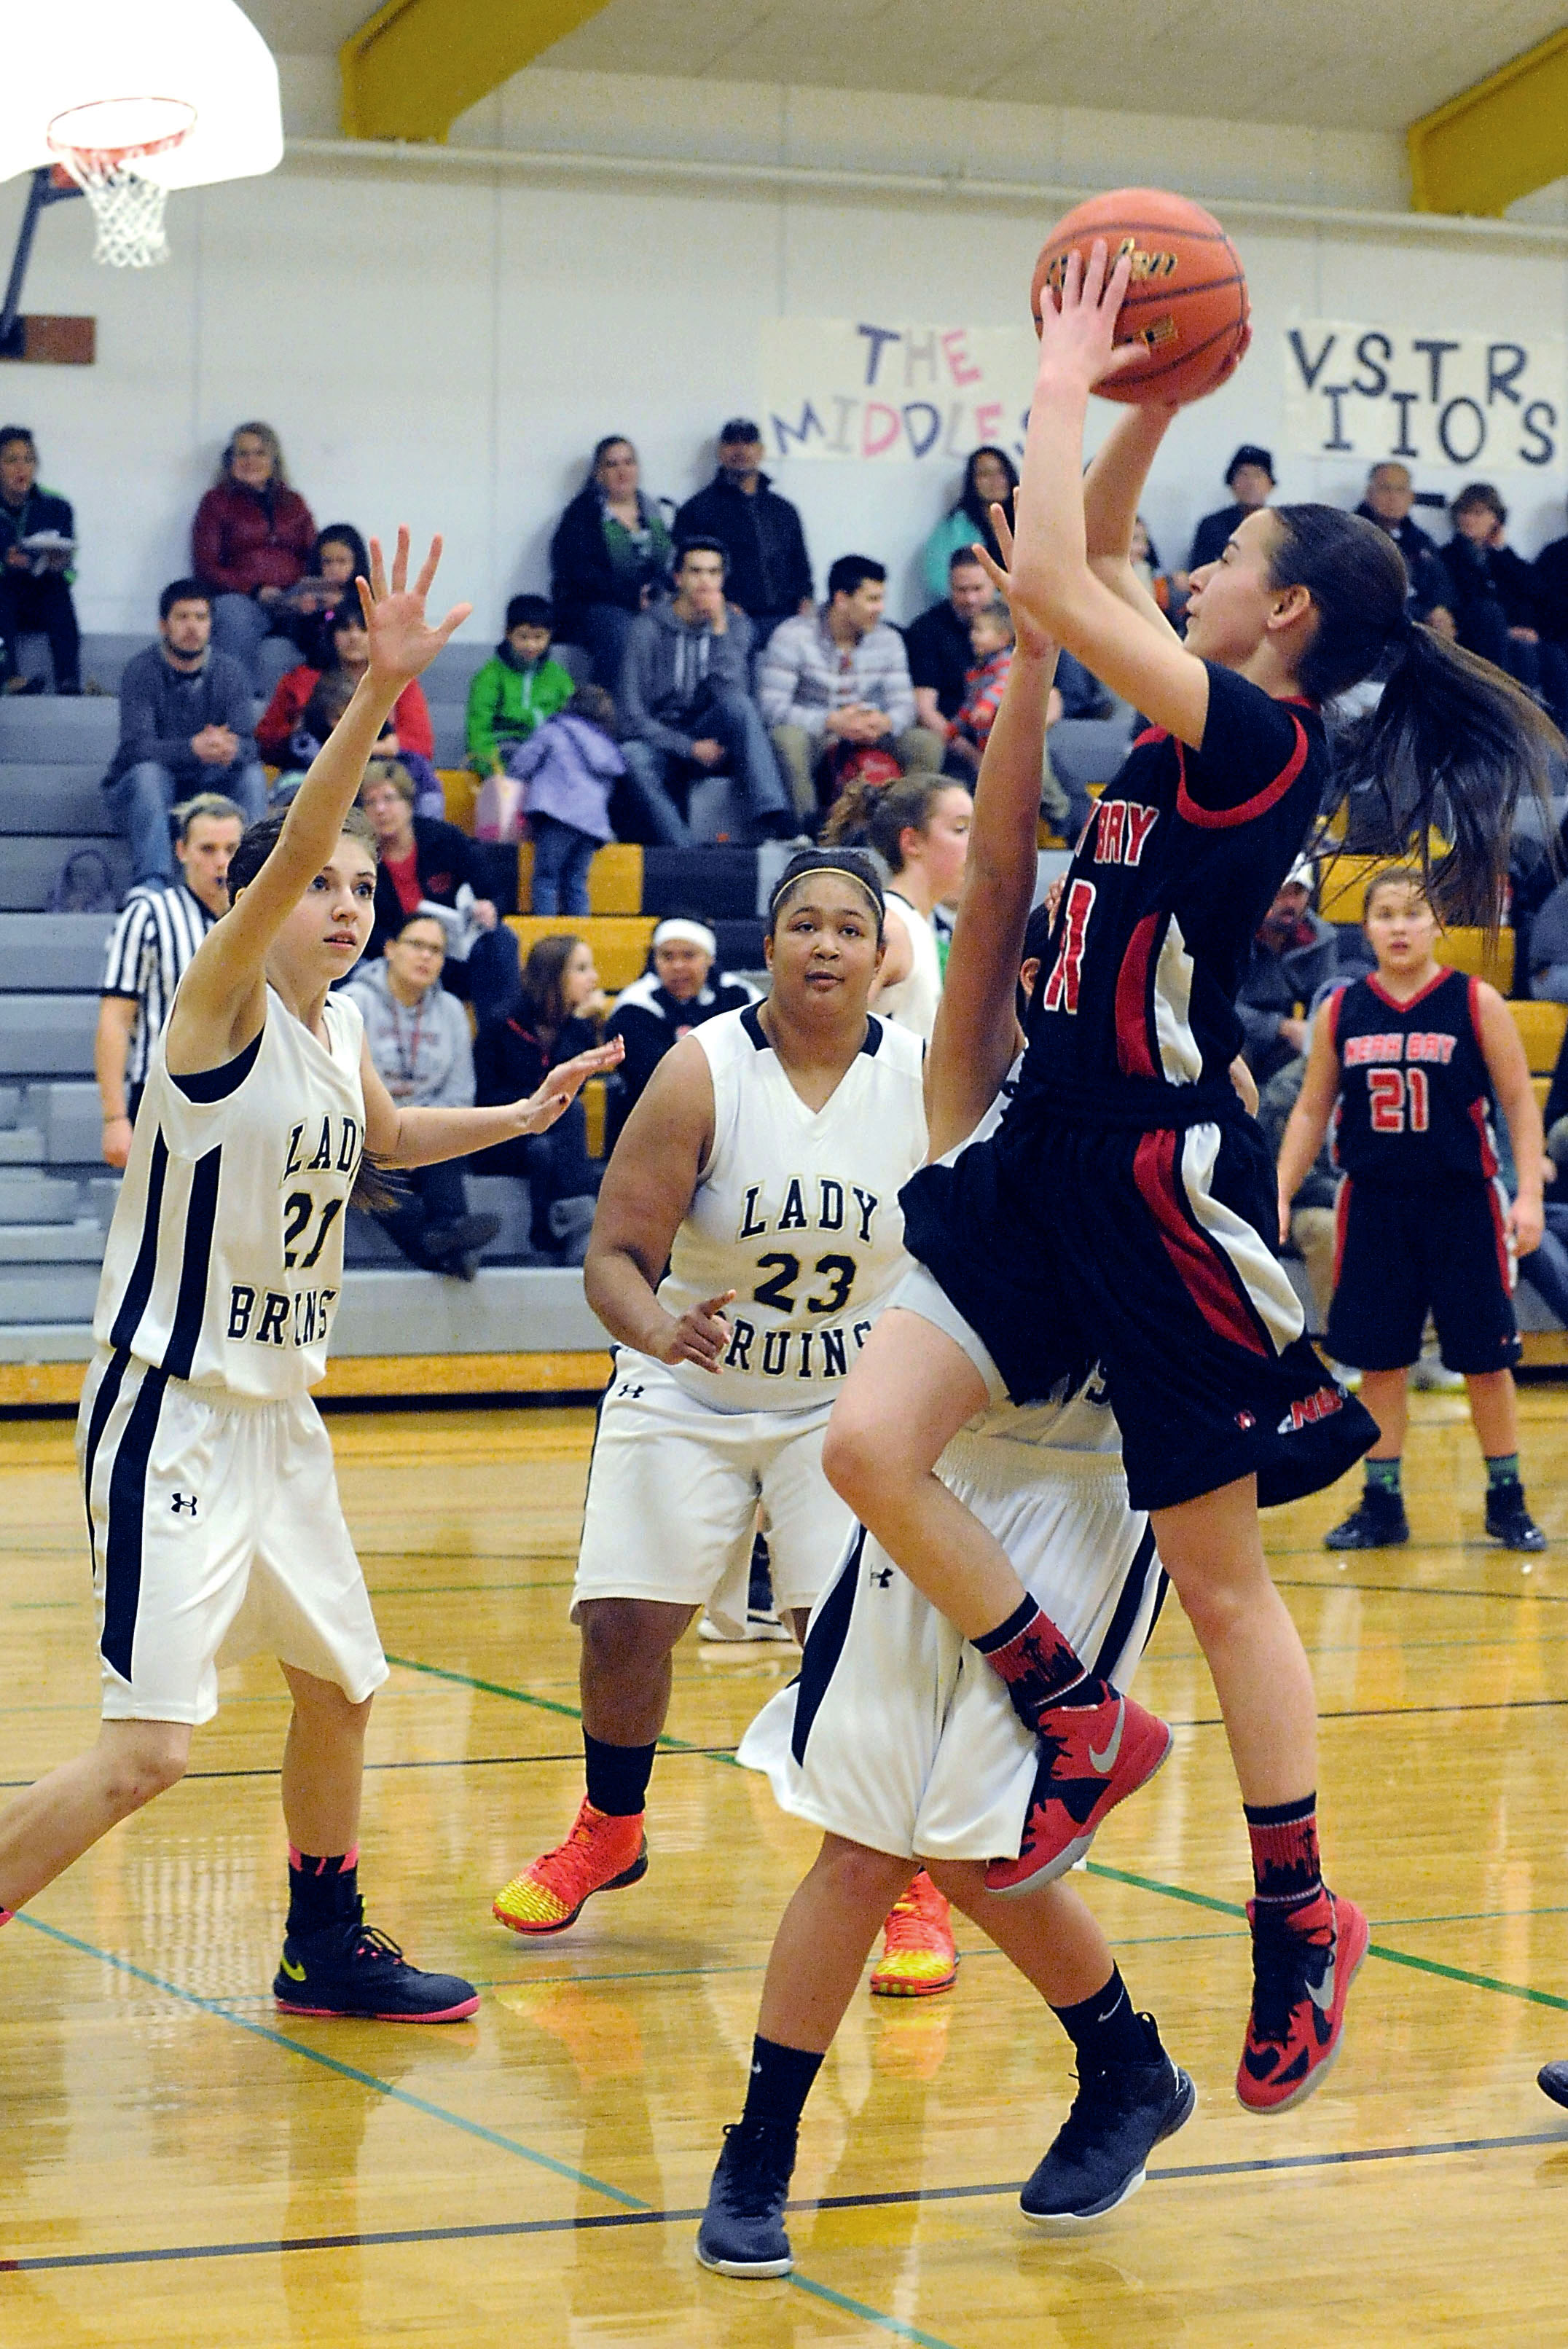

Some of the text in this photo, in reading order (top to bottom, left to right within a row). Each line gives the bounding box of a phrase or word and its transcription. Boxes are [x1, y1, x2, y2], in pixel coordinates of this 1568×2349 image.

[856, 322, 982, 388] THE
[769, 396, 1032, 459] MIDDLE
[1367, 1067, 1430, 1133] 21
[282, 1114, 364, 1182] LAD
[283, 1191, 343, 1268] 21
[740, 1178, 879, 1242] LADY
[753, 1252, 857, 1313] 23
[716, 1312, 872, 1378] RUIN
